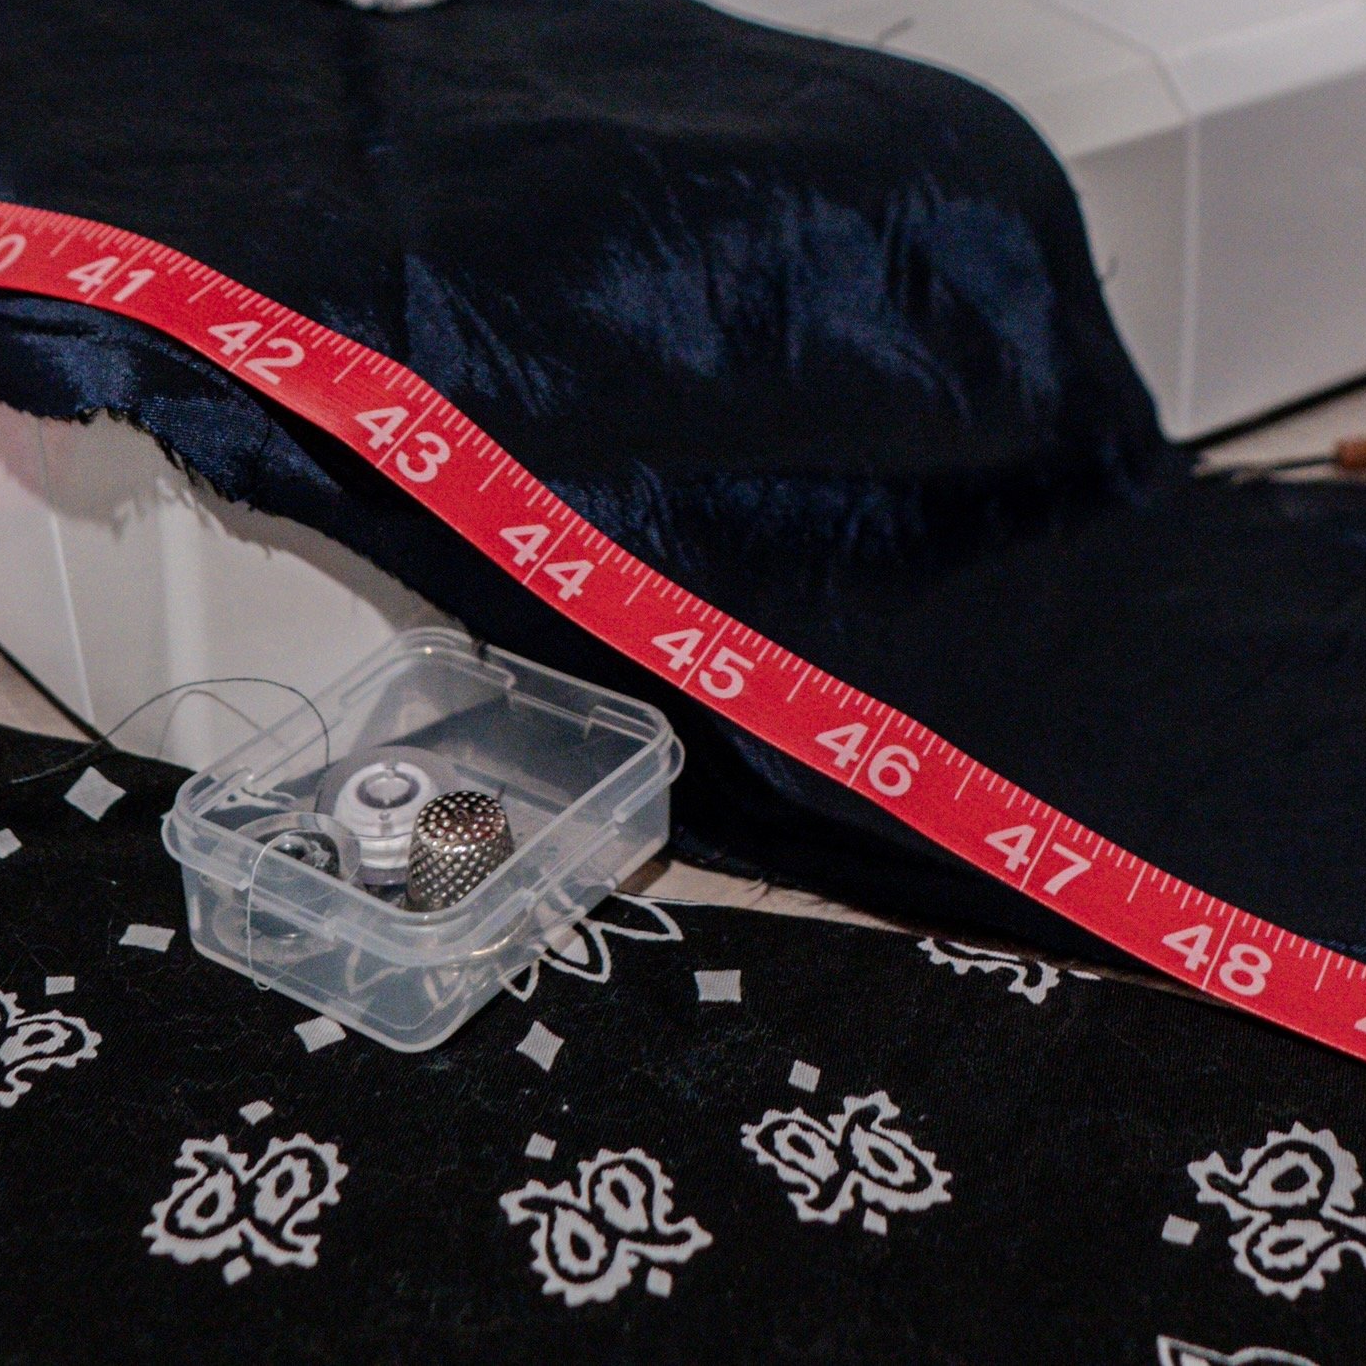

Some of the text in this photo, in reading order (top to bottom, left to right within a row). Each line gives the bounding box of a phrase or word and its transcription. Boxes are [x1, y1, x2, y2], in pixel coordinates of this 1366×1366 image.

[66, 256, 156, 302] 41
[207, 320, 305, 385] 42
[355, 406, 452, 483] 43
[499, 524, 595, 601] 44
[651, 627, 755, 699] 45
[815, 721, 920, 797] 46
[984, 824, 1092, 896] 47
[1162, 924, 1272, 997] 48
